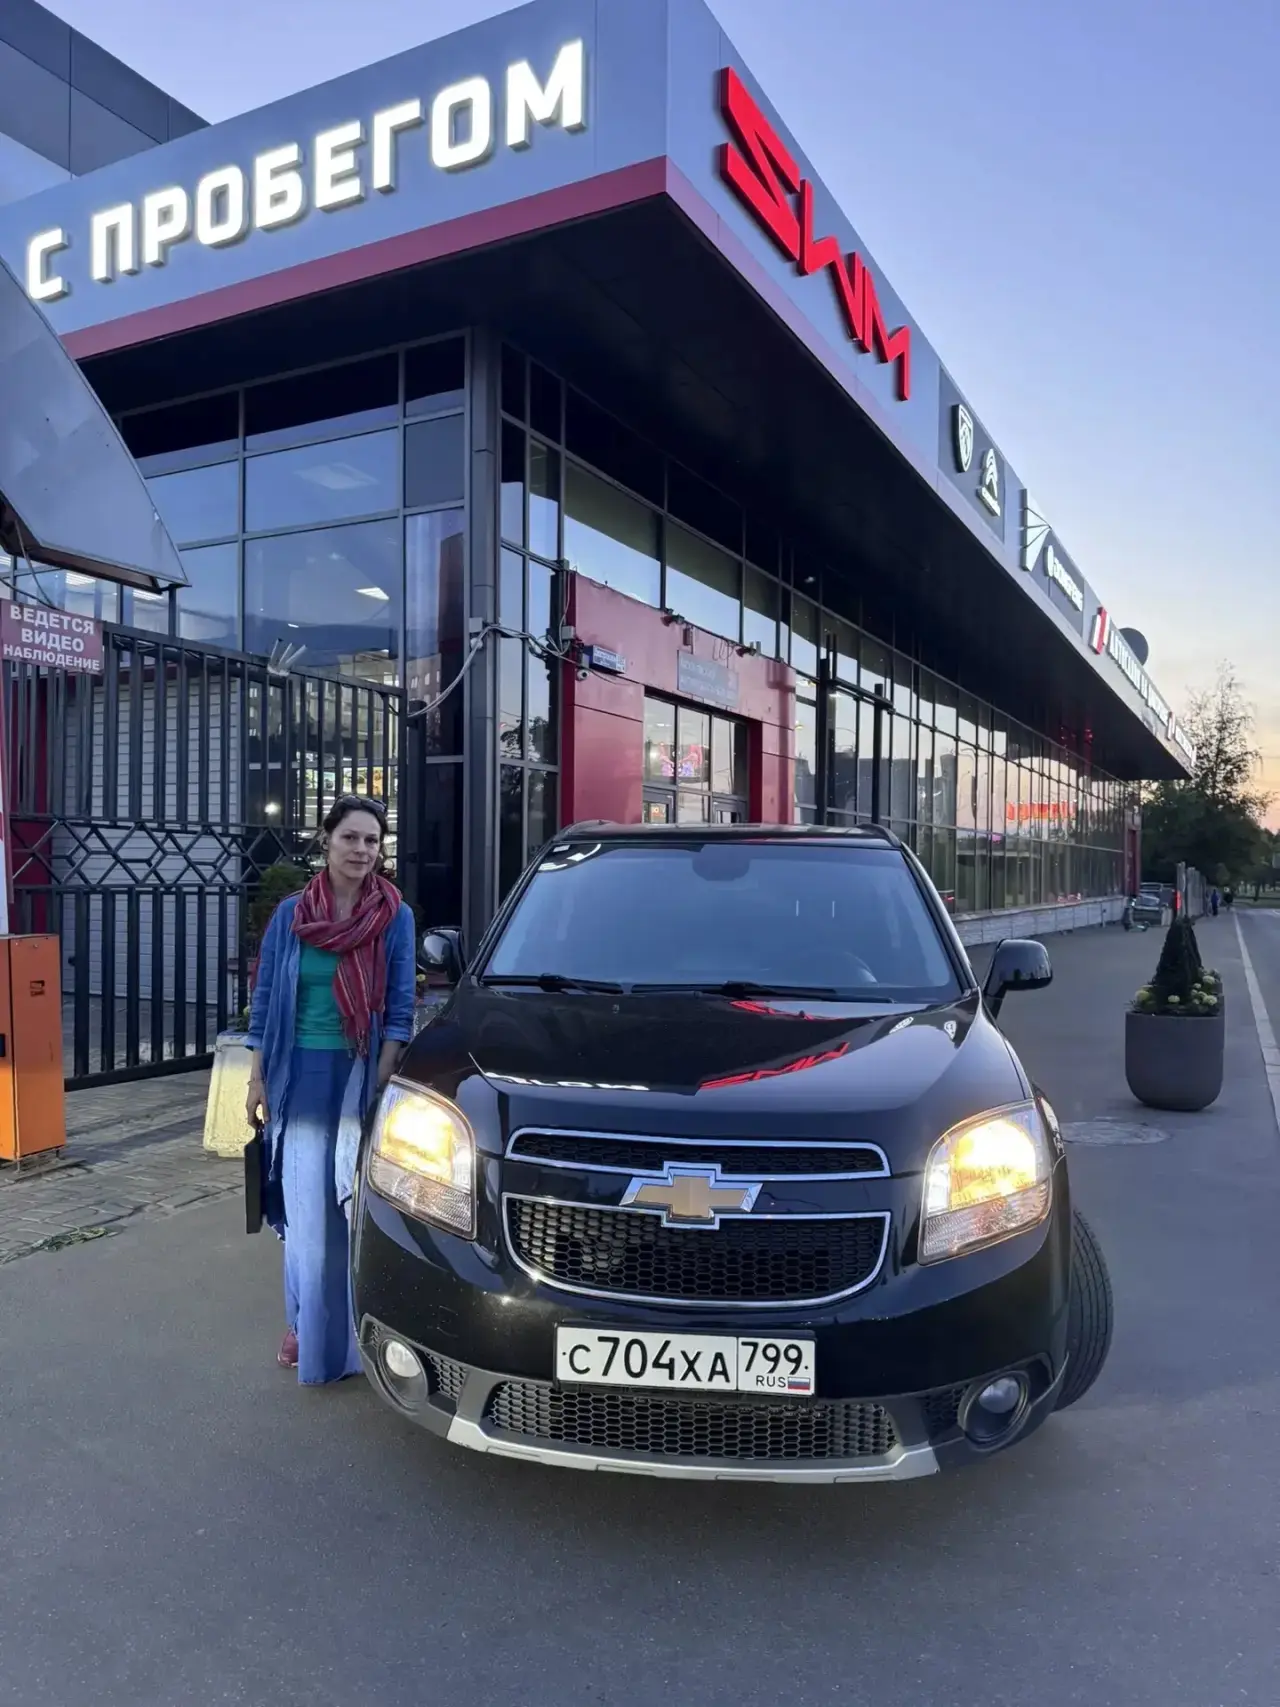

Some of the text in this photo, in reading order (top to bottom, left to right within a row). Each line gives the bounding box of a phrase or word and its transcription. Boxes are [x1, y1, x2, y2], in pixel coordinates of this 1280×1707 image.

[27, 37, 587, 302] С ПРОБЕГОМ
[10, 604, 95, 636] ВЕДЕТСЯ
[21, 627, 85, 654] ВИДЕО
[3, 643, 100, 671] НАБЛЮДЕНИЕ
[741, 1341, 803, 1376] 799
[755, 1374, 787, 1389] RUS
